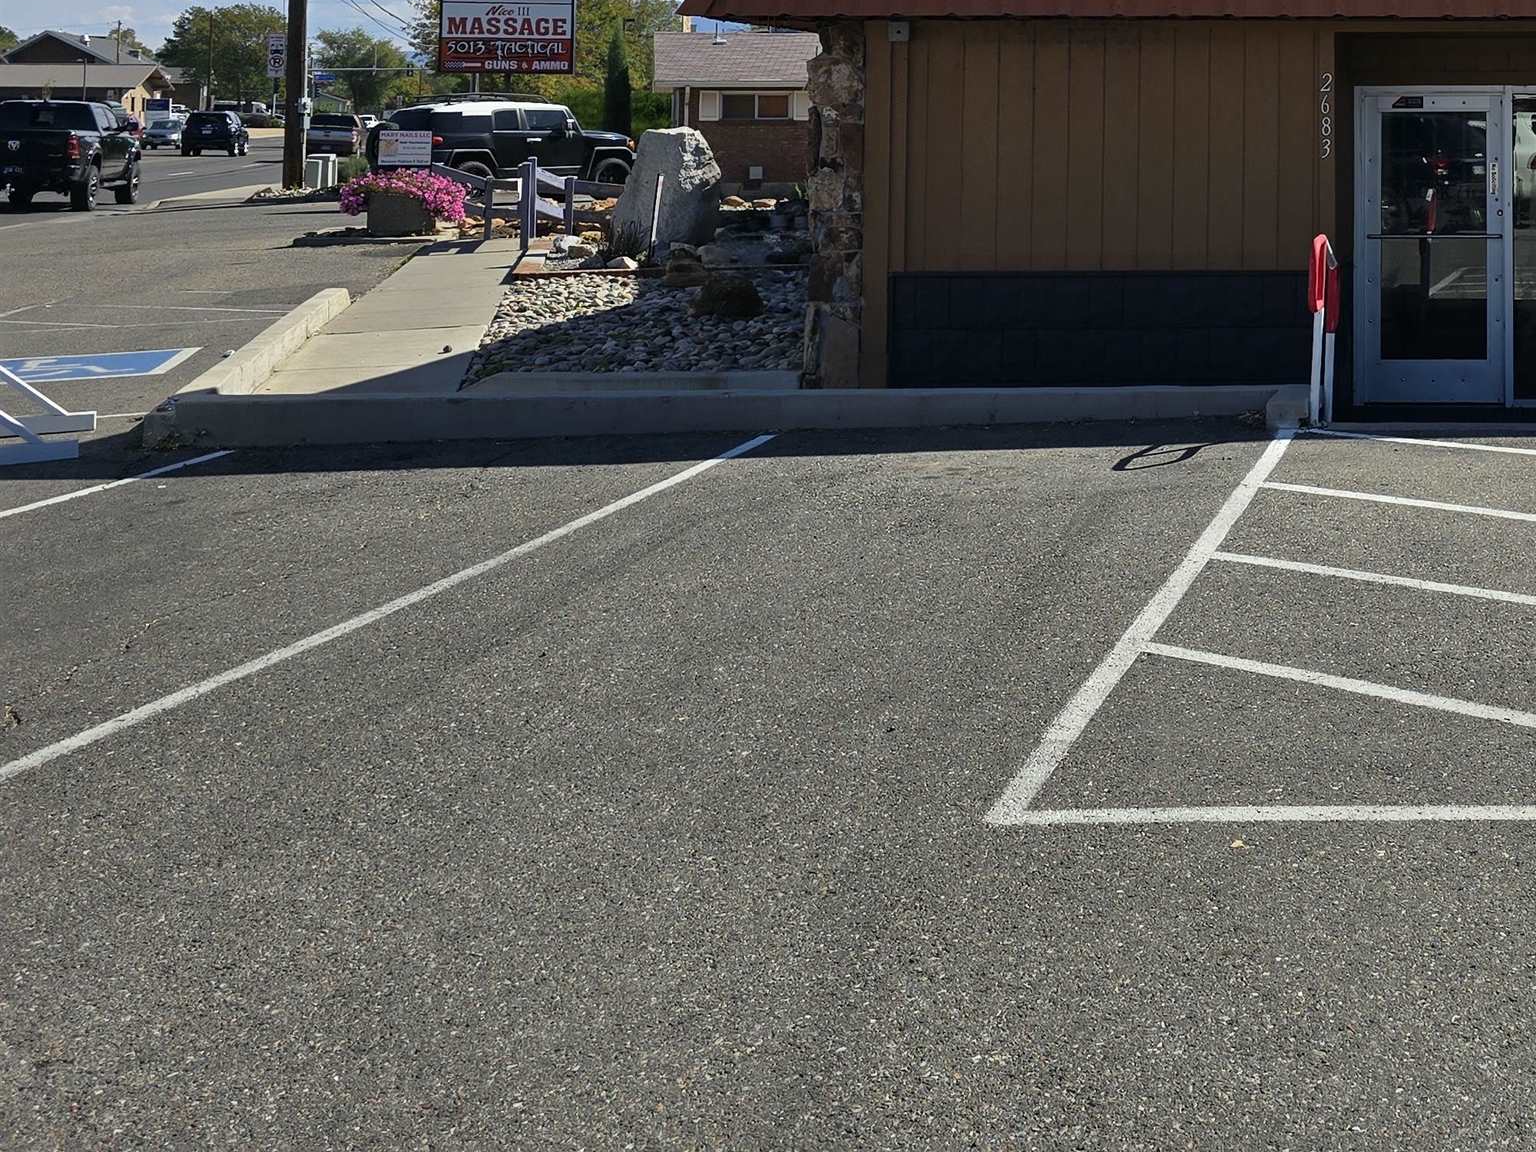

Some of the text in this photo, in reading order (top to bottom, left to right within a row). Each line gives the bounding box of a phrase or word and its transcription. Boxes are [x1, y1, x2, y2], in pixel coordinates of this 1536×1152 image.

[446, 16, 568, 36] MASSAGE
[447, 40, 567, 59] 5013 TACTICAL
[484, 60, 518, 70] GUNS
[532, 60, 569, 71] AMMO
[1319, 72, 1333, 159] 2683
